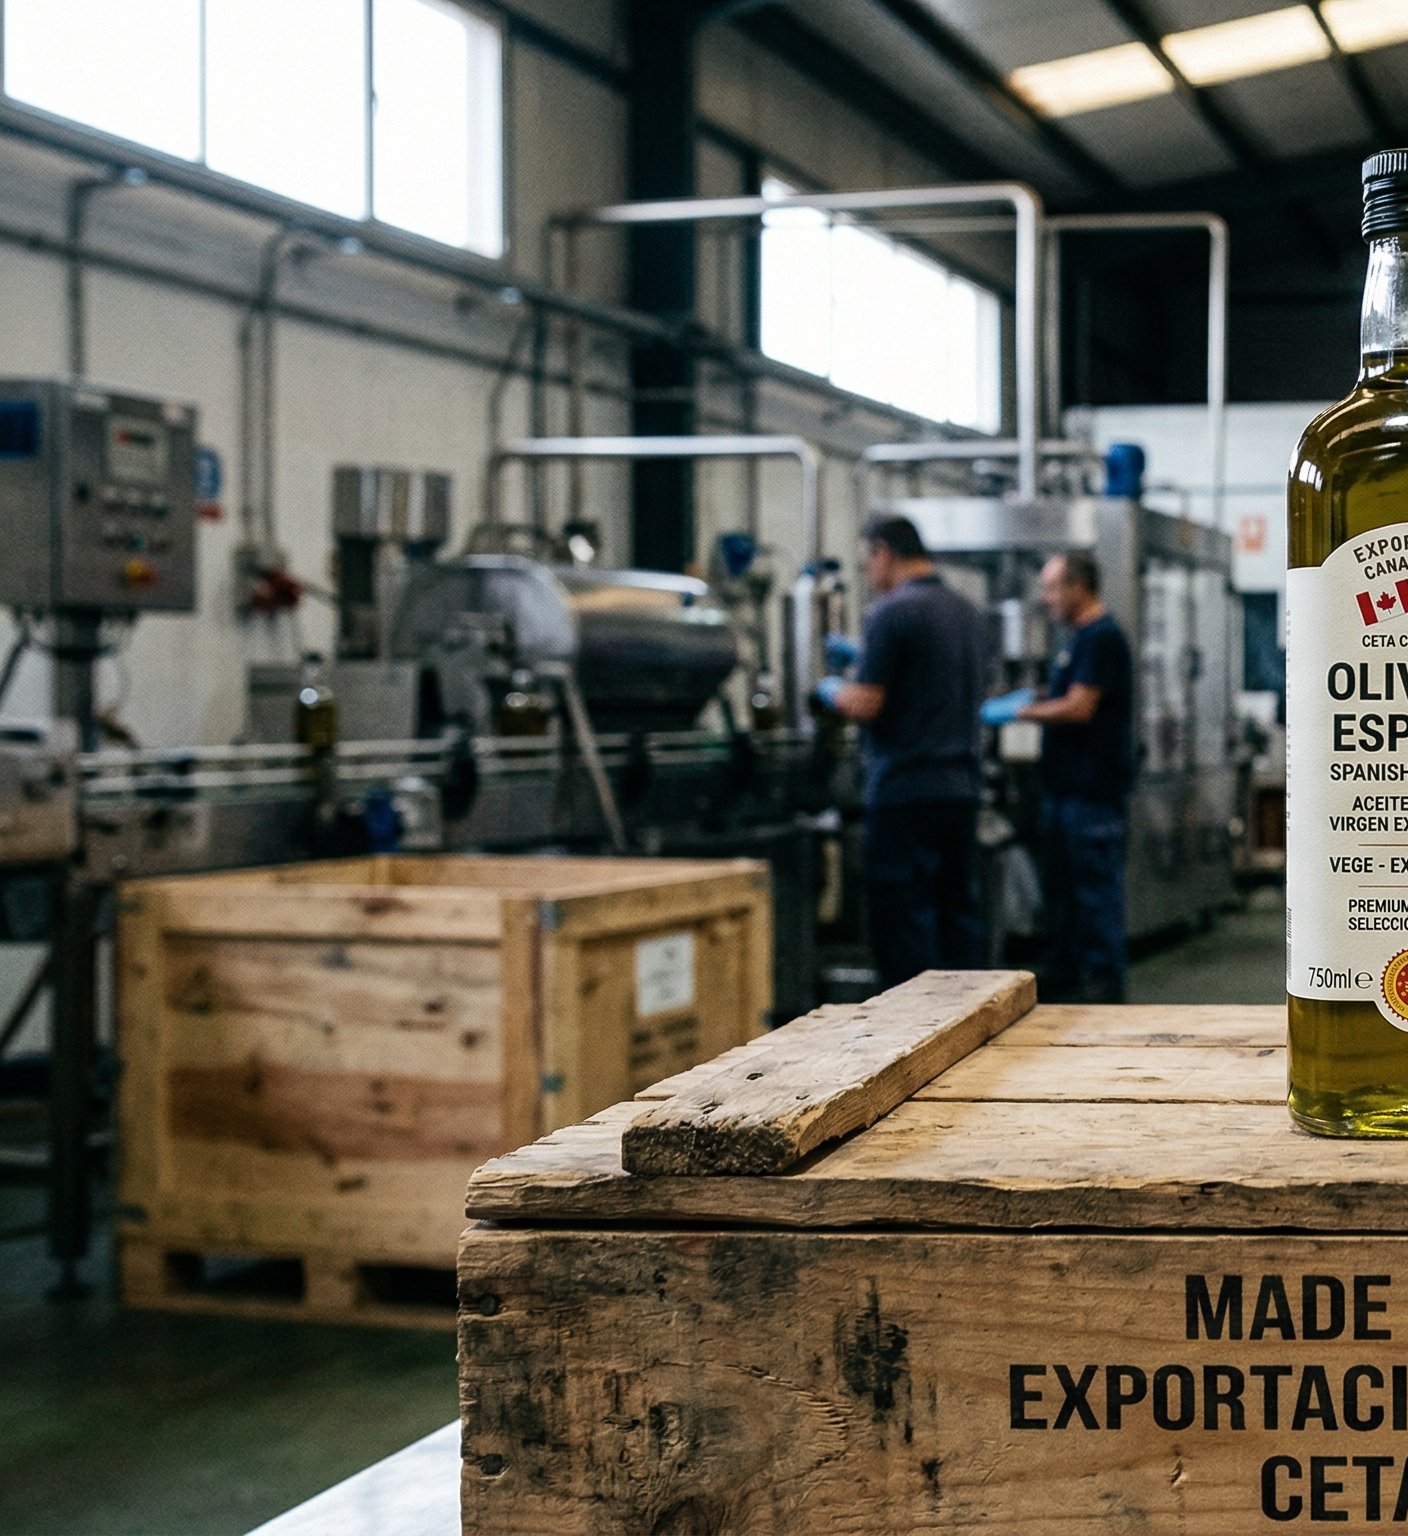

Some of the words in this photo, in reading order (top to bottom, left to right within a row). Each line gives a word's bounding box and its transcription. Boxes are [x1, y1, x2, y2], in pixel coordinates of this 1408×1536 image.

[1363, 635, 1395, 647] CETA
[1330, 817, 1388, 831] VIRGEN
[1330, 857, 1373, 873] VEGE
[1186, 1275, 1391, 1340] MADE
